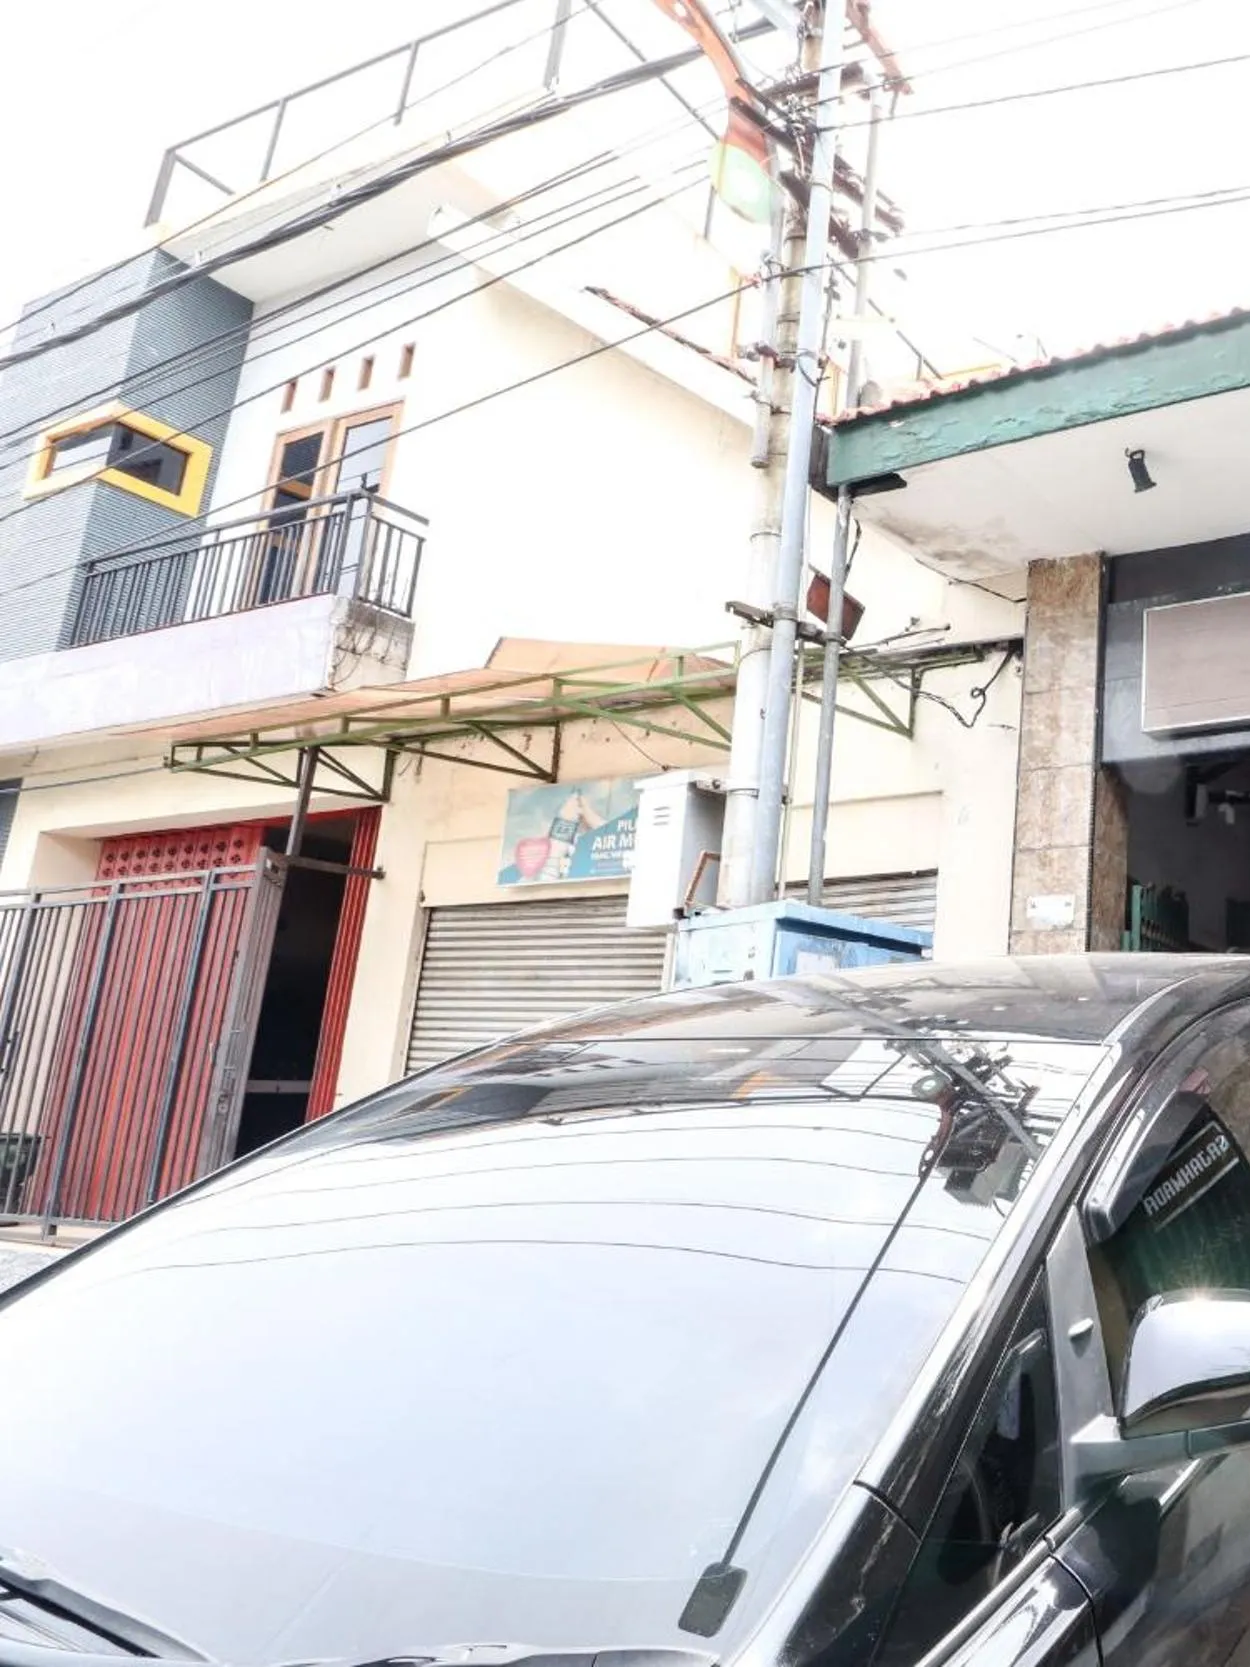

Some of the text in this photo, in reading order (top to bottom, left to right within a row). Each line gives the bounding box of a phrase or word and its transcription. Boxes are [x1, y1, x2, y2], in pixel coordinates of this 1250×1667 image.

[616, 819, 635, 832] PIL
[592, 833, 635, 850] AIR M
